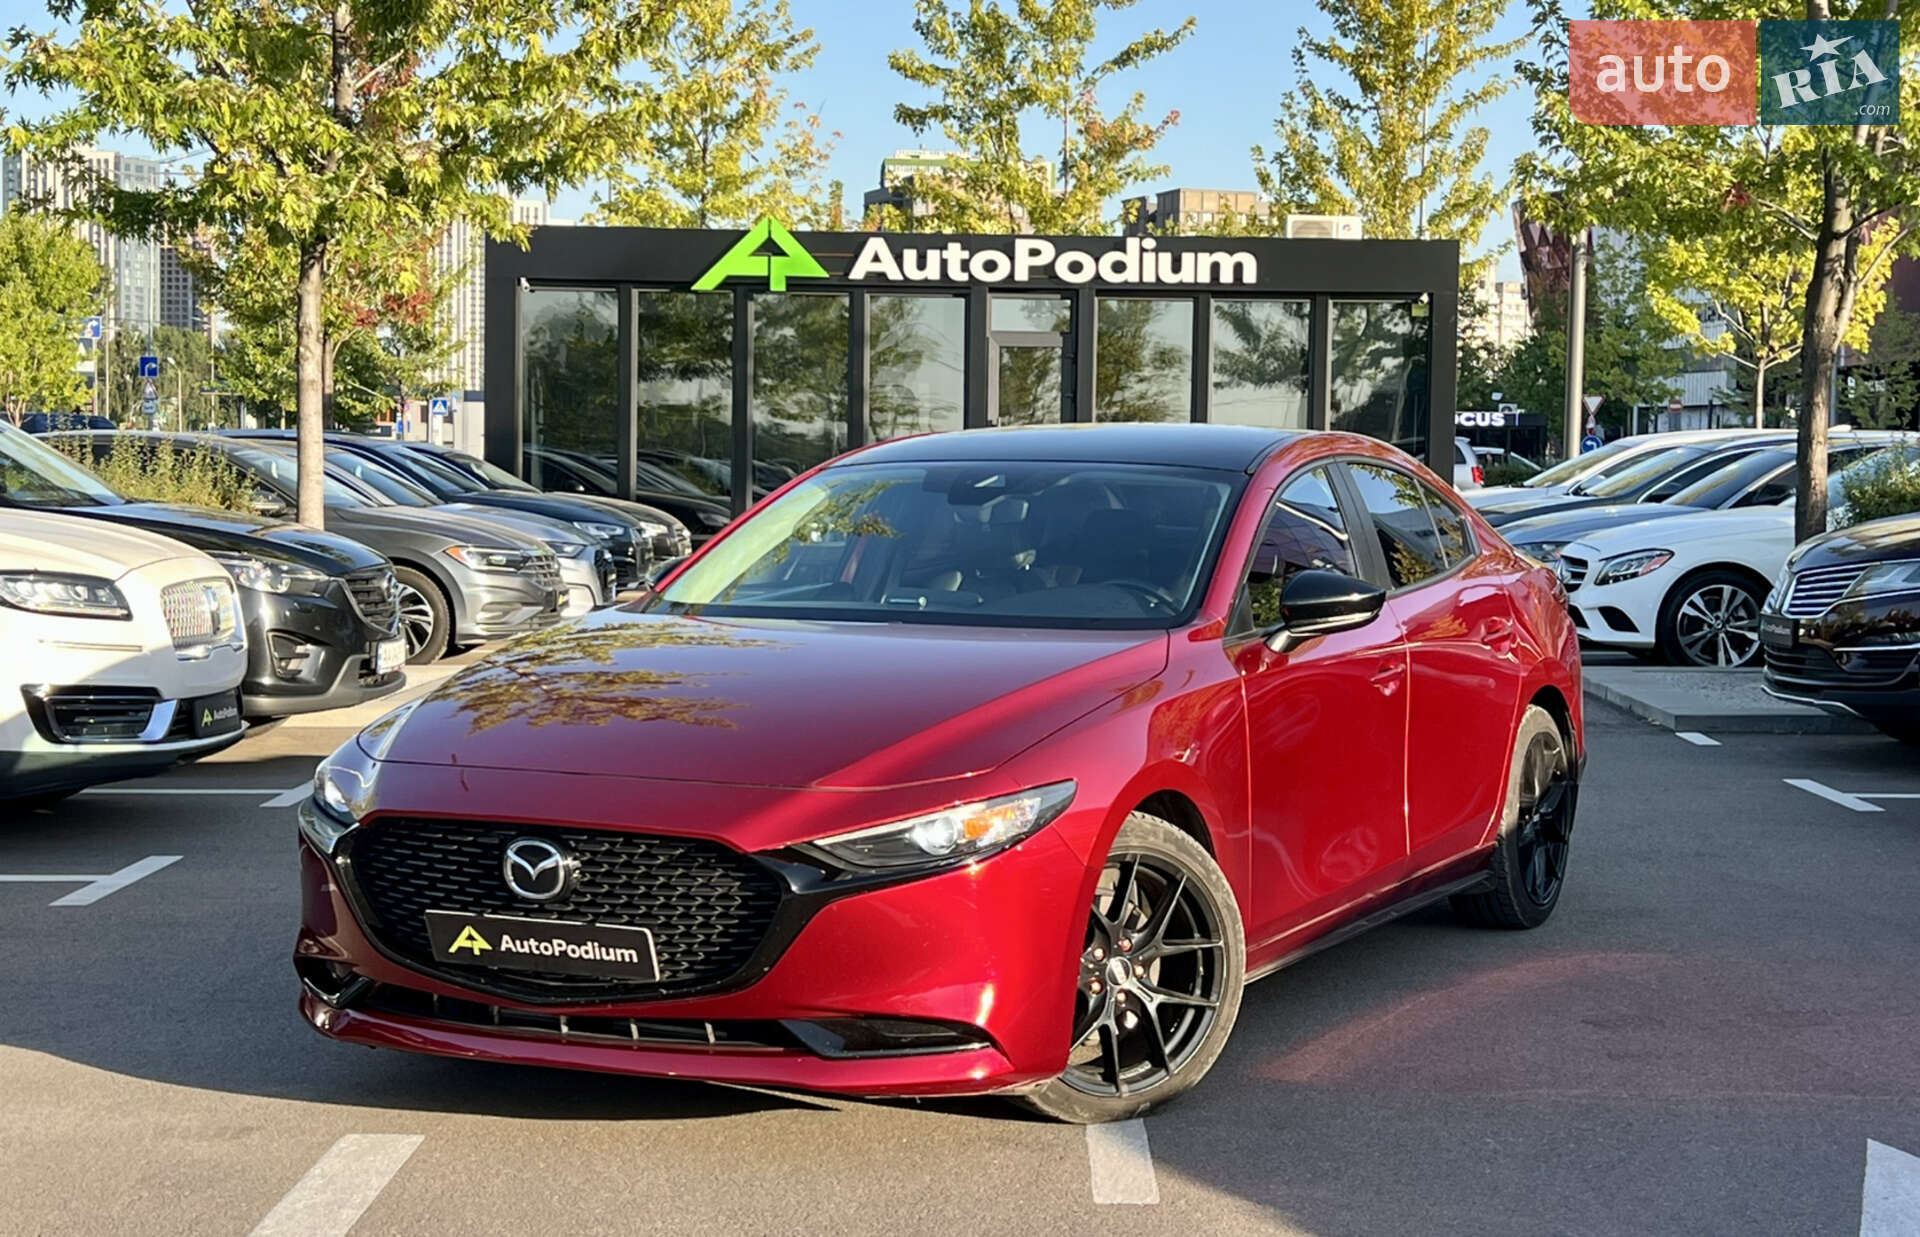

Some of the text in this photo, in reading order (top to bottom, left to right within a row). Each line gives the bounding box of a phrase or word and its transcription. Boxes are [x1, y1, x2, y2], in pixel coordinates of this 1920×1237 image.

[848, 236, 1258, 285] AutoPodium
[1455, 411, 1505, 426] CUS
[500, 934, 639, 963] AutoPodium
